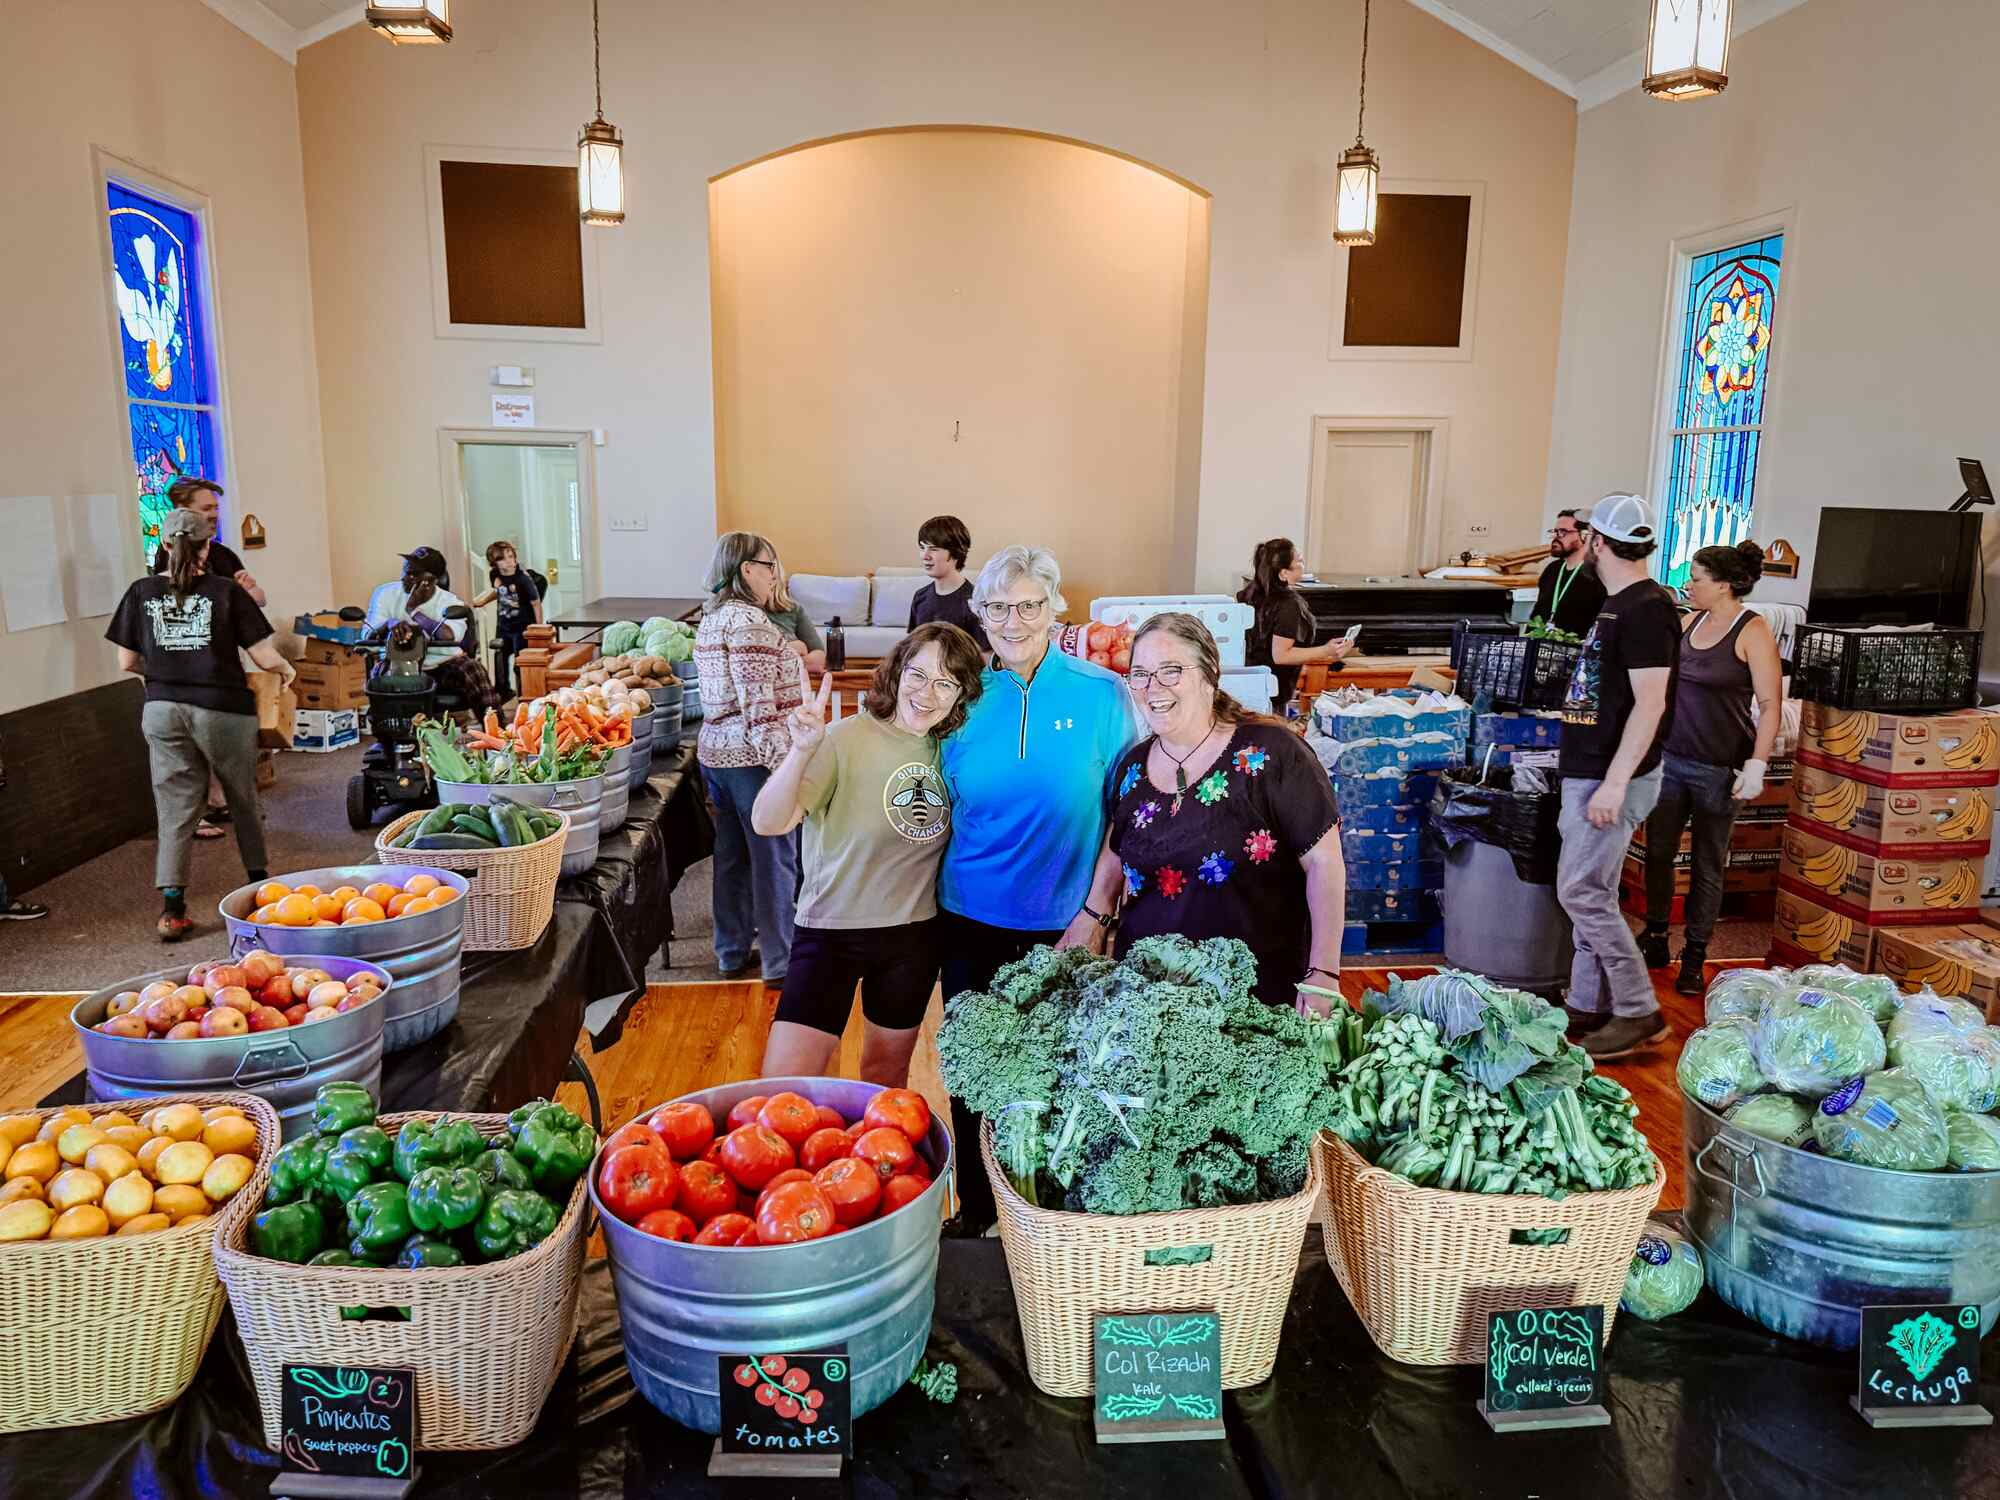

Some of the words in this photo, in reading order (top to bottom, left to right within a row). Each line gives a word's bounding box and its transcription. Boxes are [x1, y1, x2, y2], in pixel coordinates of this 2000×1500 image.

[907, 820, 945, 837] CHANCE
[829, 1363, 840, 1378] 3
[1105, 1350, 1139, 1375] Col
[377, 1384, 389, 1396] 2
[1556, 1382, 1593, 1398] greens
[1868, 1366, 1972, 1404] Lechuga
[735, 1423, 840, 1449] tomates
[338, 1442, 378, 1456] peppers
